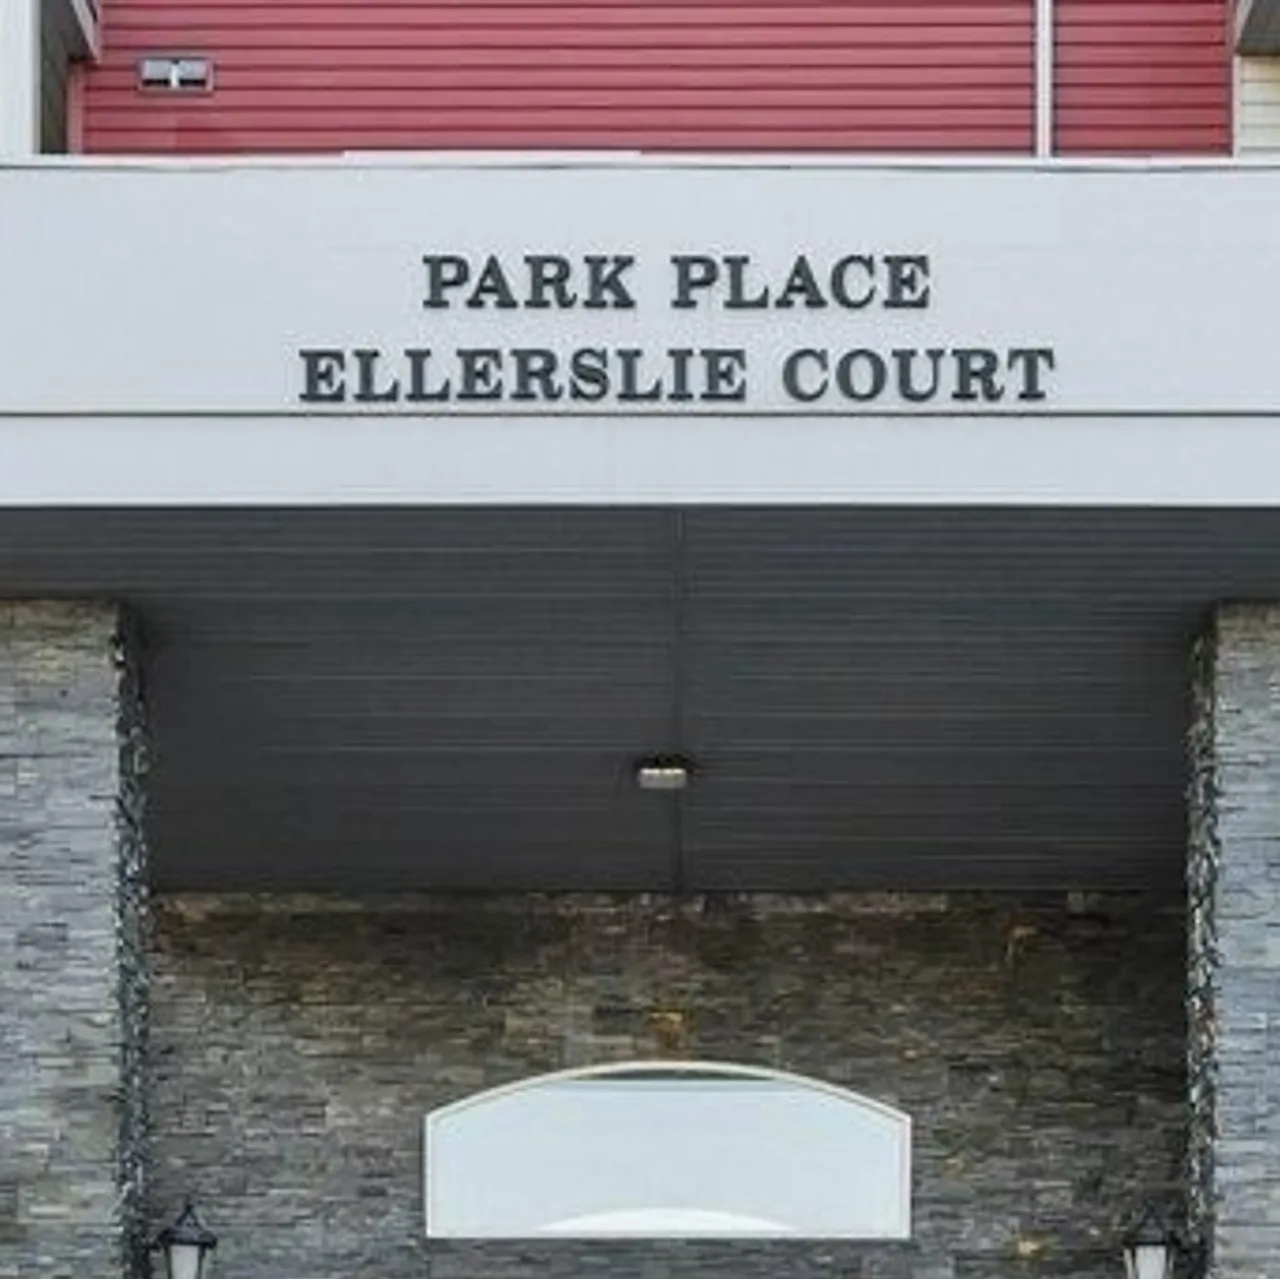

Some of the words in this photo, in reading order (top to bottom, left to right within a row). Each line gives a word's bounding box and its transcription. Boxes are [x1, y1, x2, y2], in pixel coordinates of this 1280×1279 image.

[422, 255, 637, 309] PARK
[670, 255, 933, 309] PLACE
[298, 348, 748, 402] ELLERSLIE
[782, 348, 1056, 402] COURT
